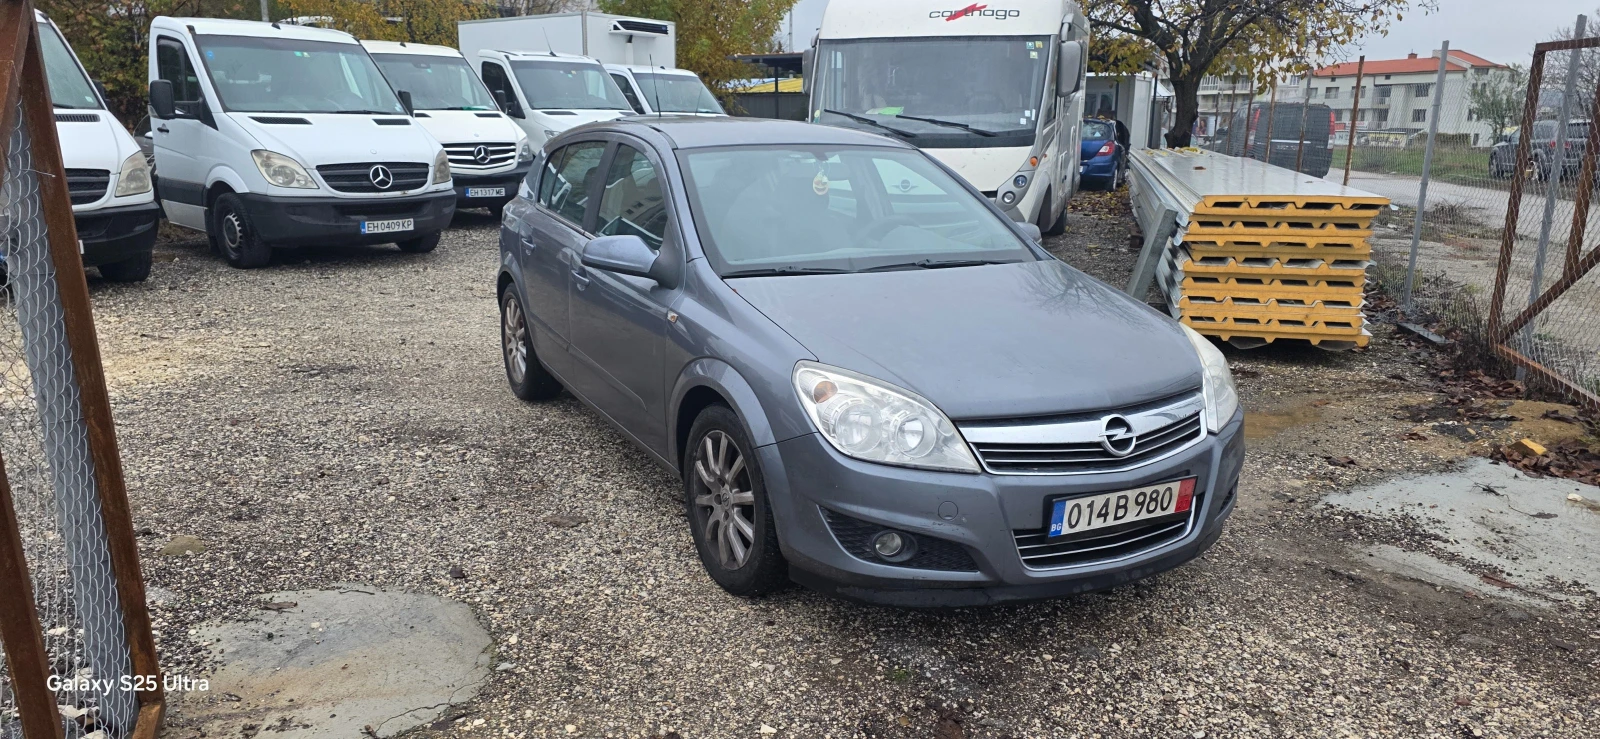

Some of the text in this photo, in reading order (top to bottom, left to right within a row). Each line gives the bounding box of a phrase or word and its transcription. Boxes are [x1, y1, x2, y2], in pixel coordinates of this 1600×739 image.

[929, 8, 1020, 20] carthago
[367, 219, 412, 232] EH 0409 KP
[1134, 487, 1173, 517] 980
[1051, 522, 1062, 532] BG
